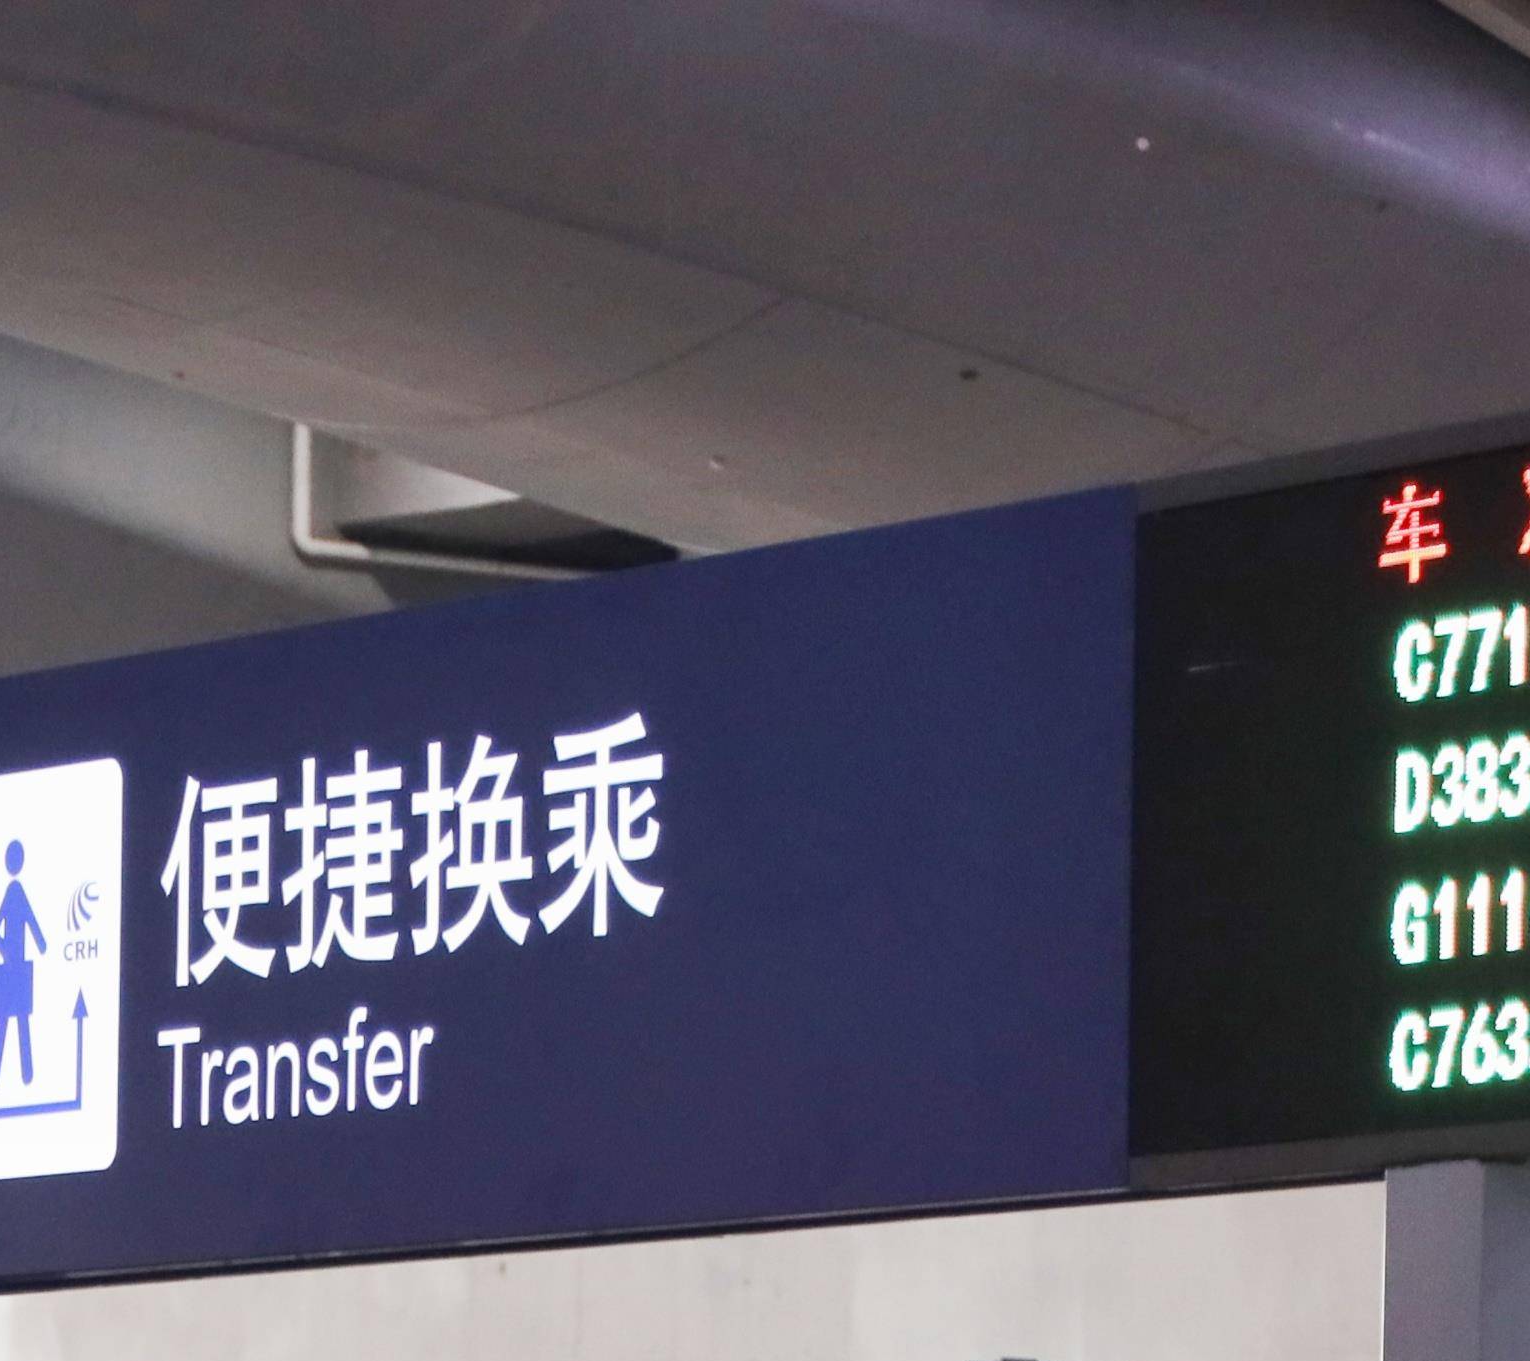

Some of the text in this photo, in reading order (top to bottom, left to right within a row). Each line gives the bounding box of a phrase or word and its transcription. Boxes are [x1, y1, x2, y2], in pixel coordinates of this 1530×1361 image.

[160, 711, 665, 987] 便捷换乘
[63, 938, 100, 962] CRH
[157, 1006, 435, 1129] Transfer
